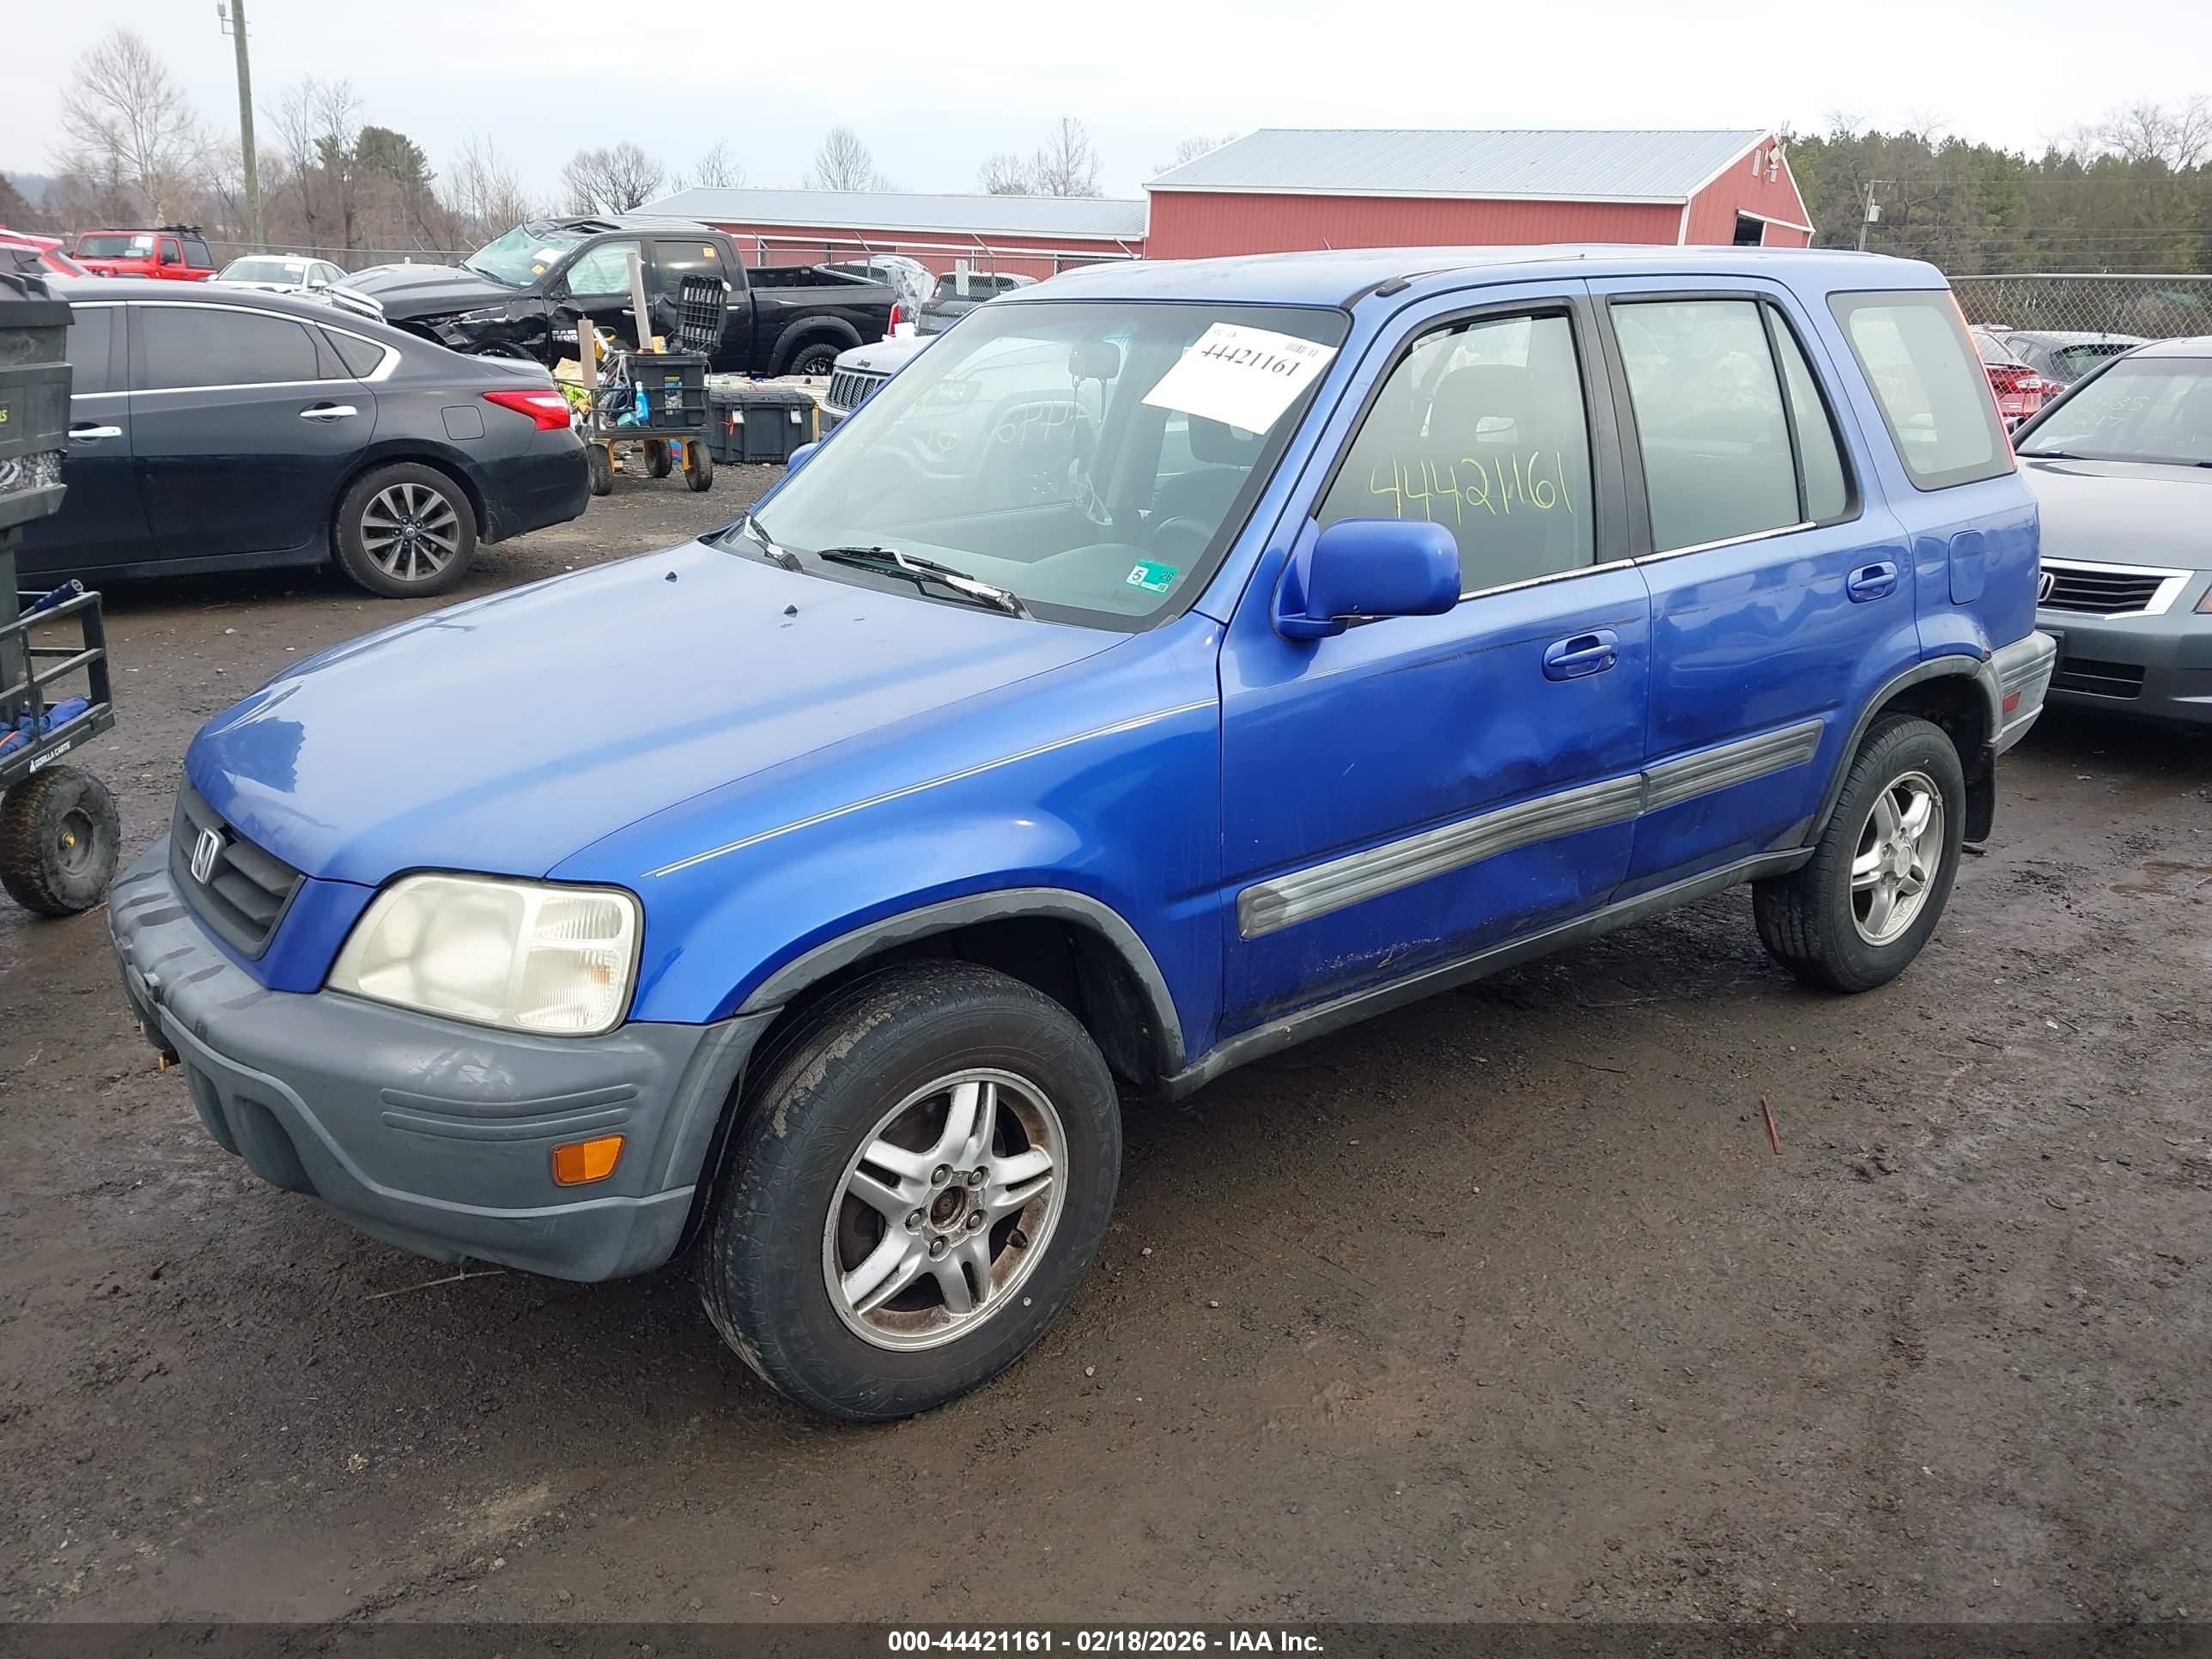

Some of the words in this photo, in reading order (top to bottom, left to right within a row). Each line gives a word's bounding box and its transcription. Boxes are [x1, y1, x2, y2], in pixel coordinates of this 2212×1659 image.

[1201, 343, 1301, 376] 44421161
[1370, 452, 1573, 527] 44421161
[1132, 569, 1144, 581] 5
[1160, 570, 1175, 581] 26
